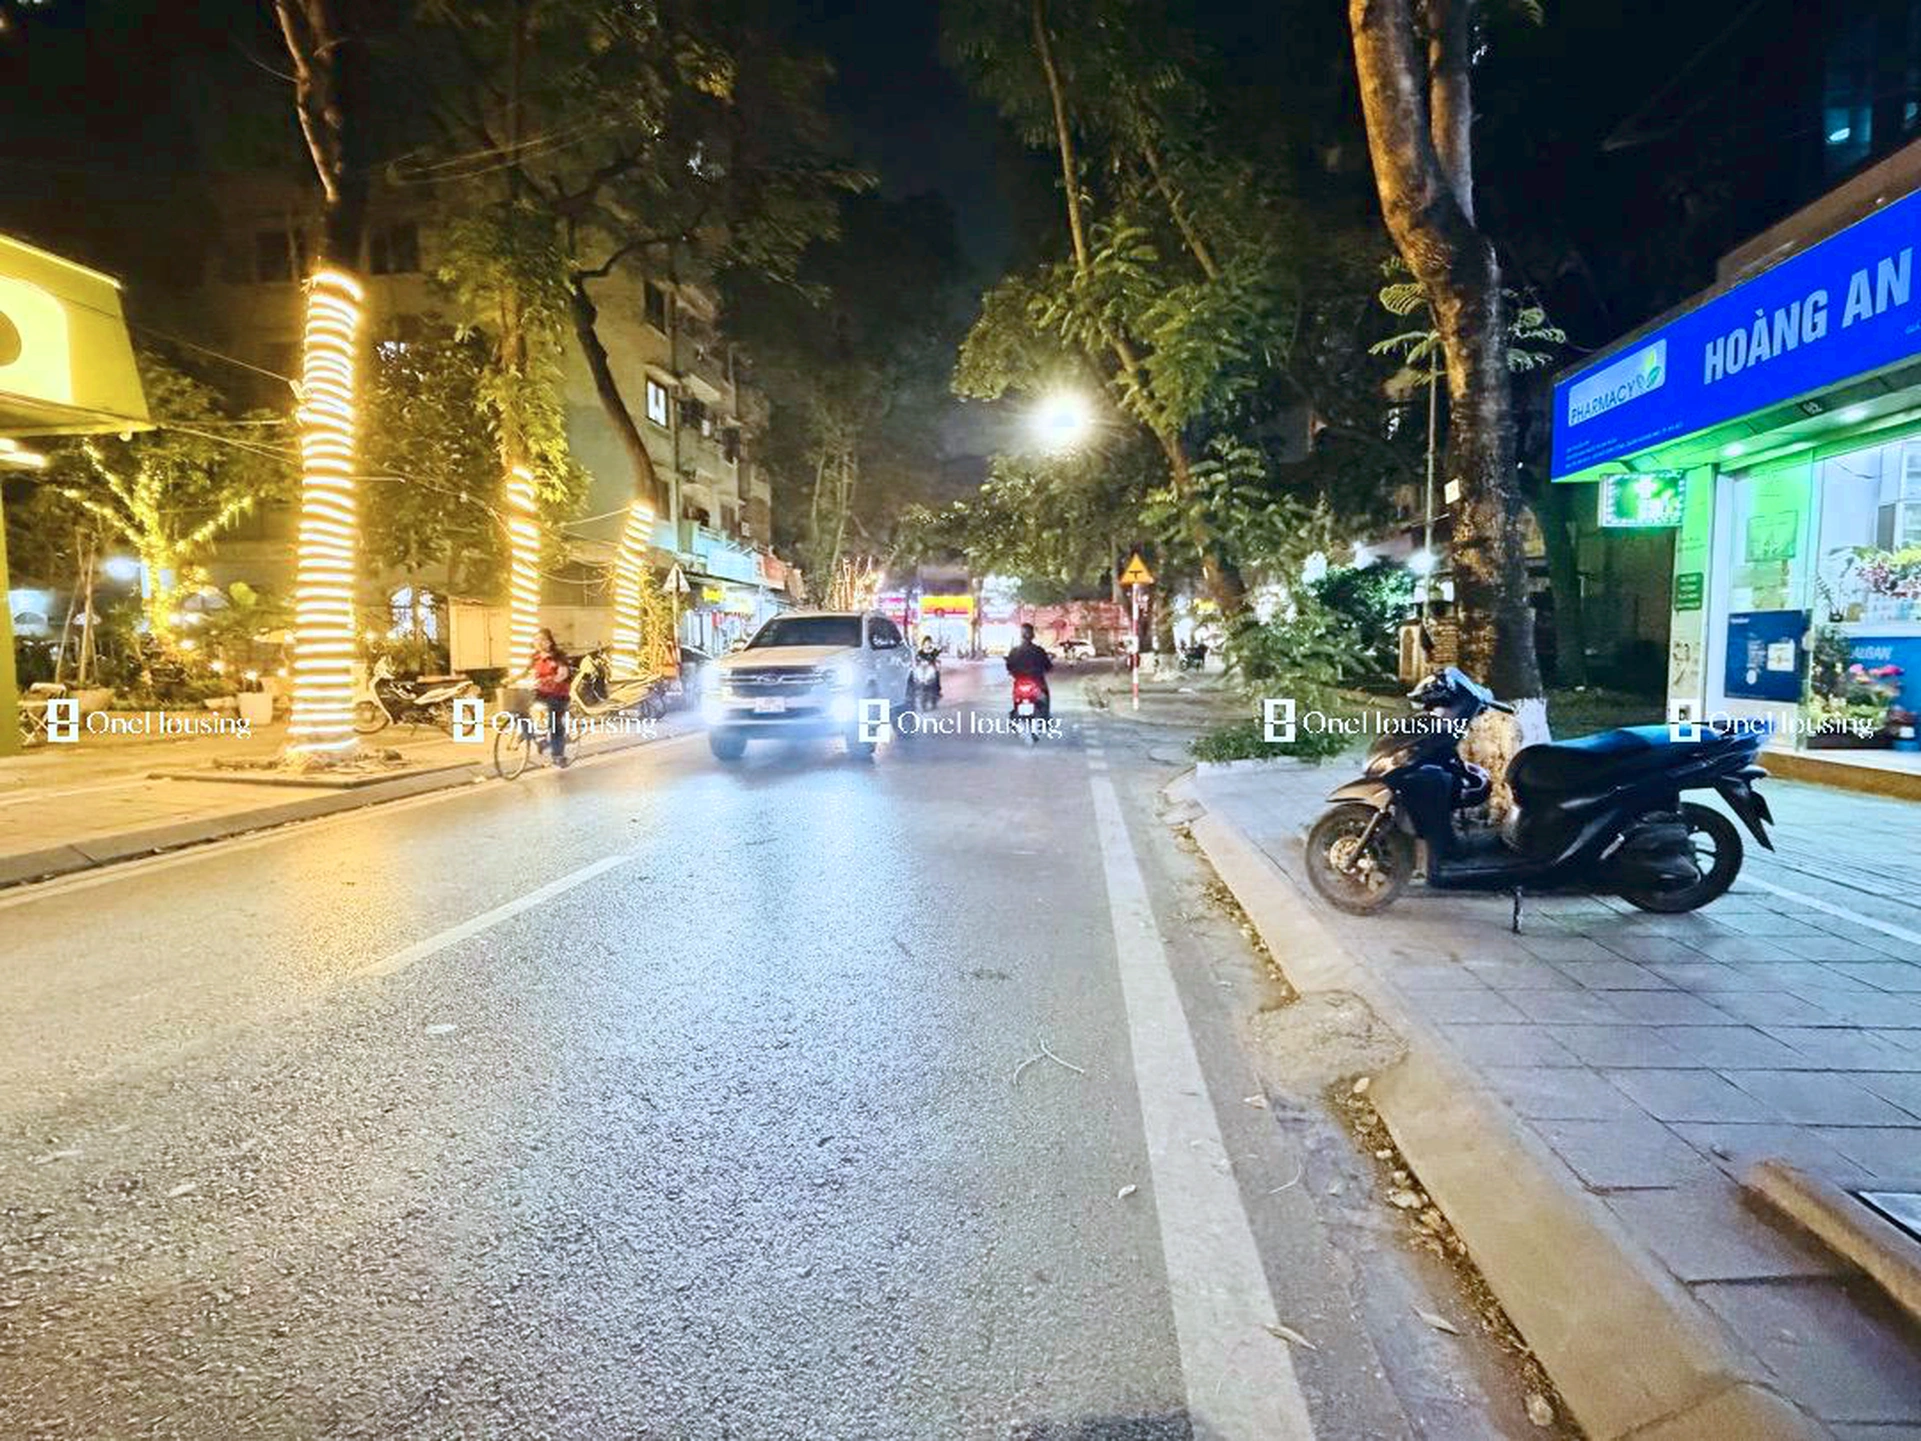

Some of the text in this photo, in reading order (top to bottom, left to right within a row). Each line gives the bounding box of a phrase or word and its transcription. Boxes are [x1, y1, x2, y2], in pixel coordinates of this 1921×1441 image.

[1703, 247, 1913, 385] HOÀNG AN
[1570, 378, 1636, 426] PHARMACY
